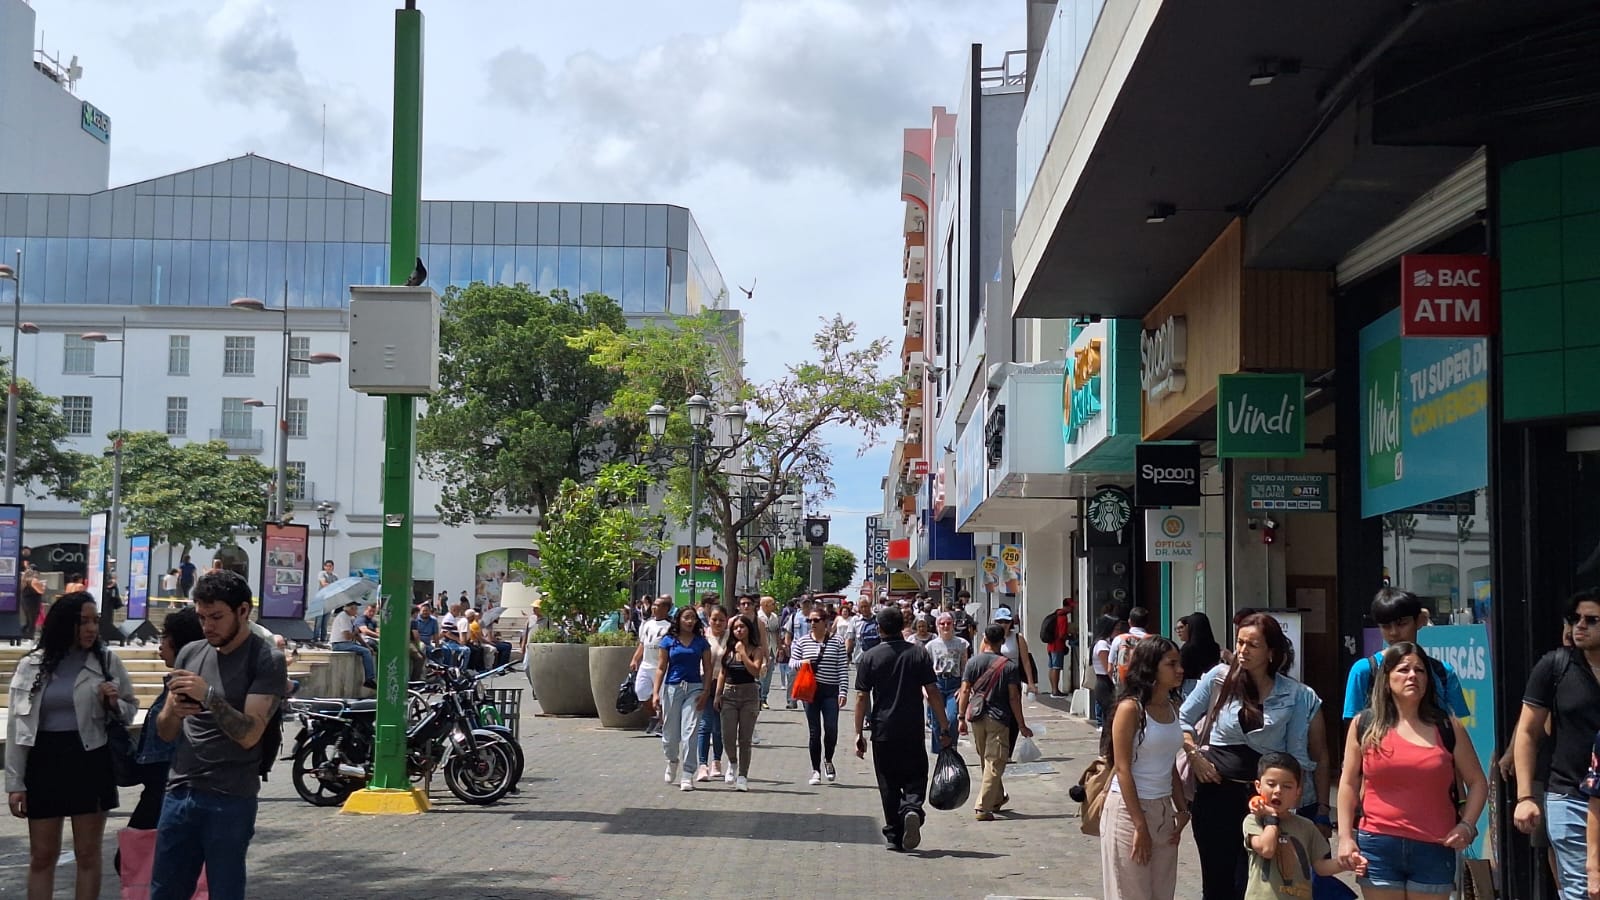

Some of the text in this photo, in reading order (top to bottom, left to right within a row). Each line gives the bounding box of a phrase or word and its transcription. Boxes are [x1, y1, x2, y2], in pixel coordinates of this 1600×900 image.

[1437, 269, 1481, 287] BAC
[1413, 299, 1481, 323] ATM
[1140, 315, 1177, 403] Spoon
[1410, 368, 1428, 403] TU
[1429, 348, 1472, 395] SUPER
[1228, 393, 1296, 435] Vindi
[1368, 370, 1401, 457] Vindi
[1141, 464, 1196, 485] Spoon
[1172, 548, 1193, 556] MAX
[681, 578, 717, 588] Aorrá
